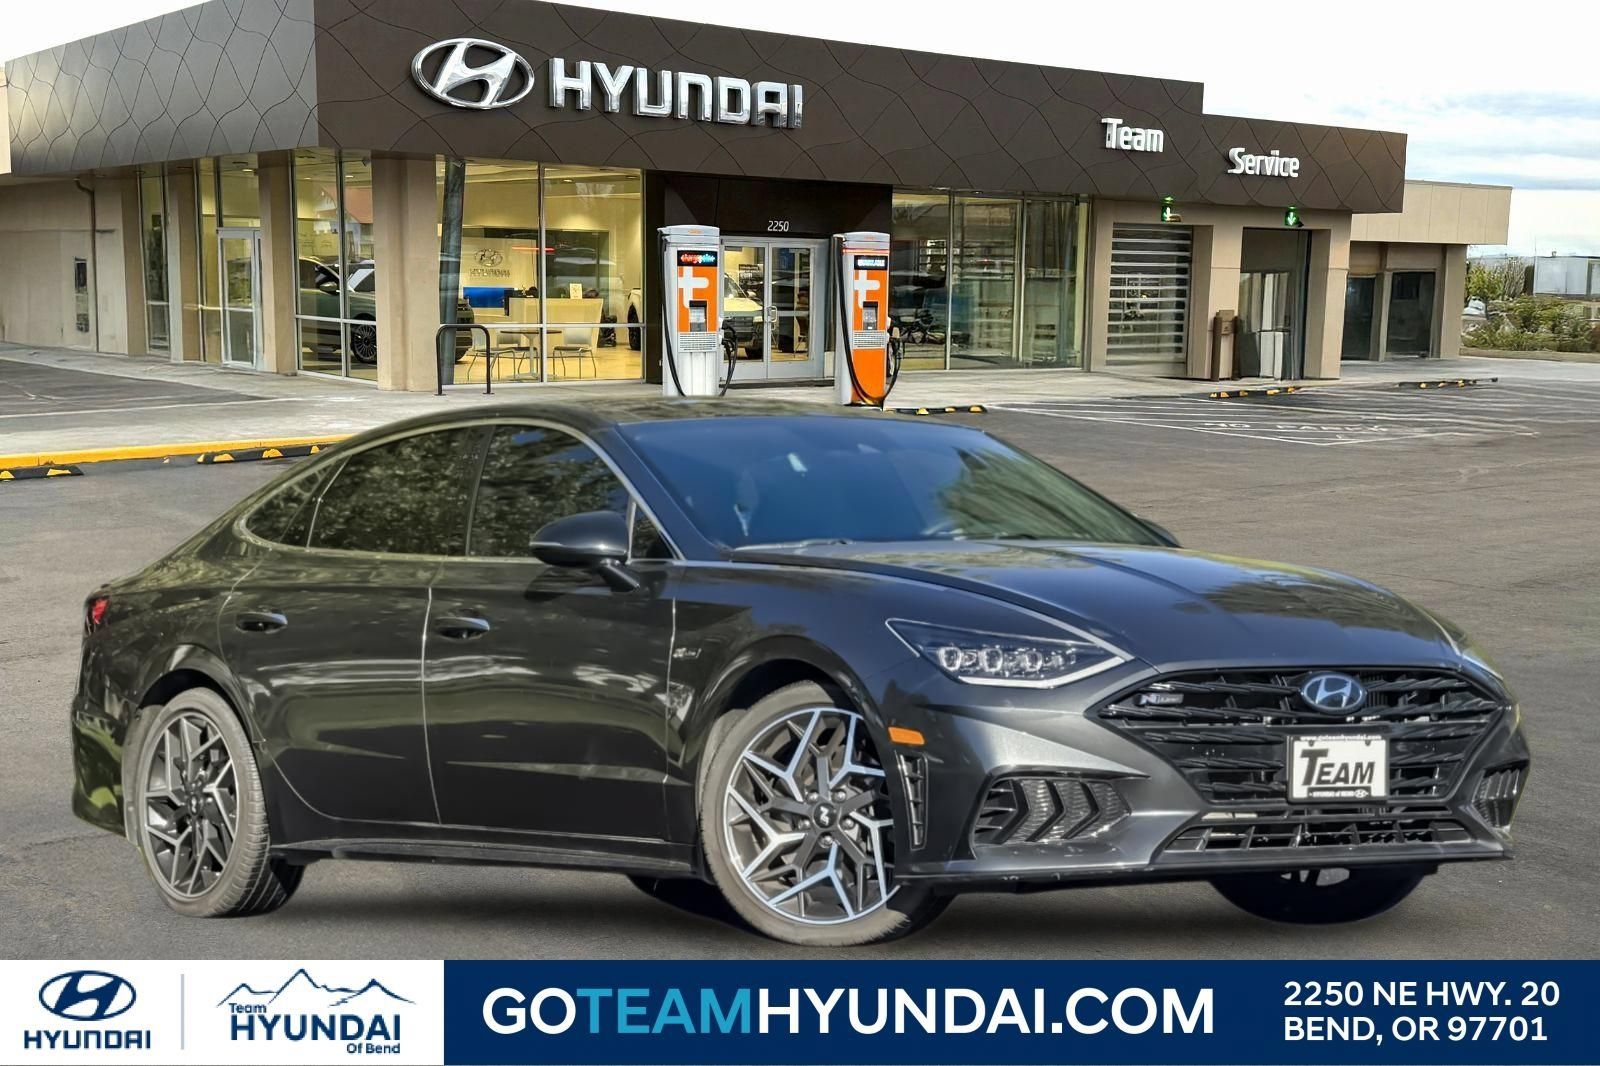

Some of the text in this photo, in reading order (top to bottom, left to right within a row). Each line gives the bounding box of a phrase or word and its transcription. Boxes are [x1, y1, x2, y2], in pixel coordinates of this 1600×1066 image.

[549, 57, 803, 128] HYUNDAI
[1101, 117, 1164, 153] Team
[1227, 147, 1300, 178] Service
[767, 220, 790, 232] 2250
[1300, 748, 1376, 786] TEAM
